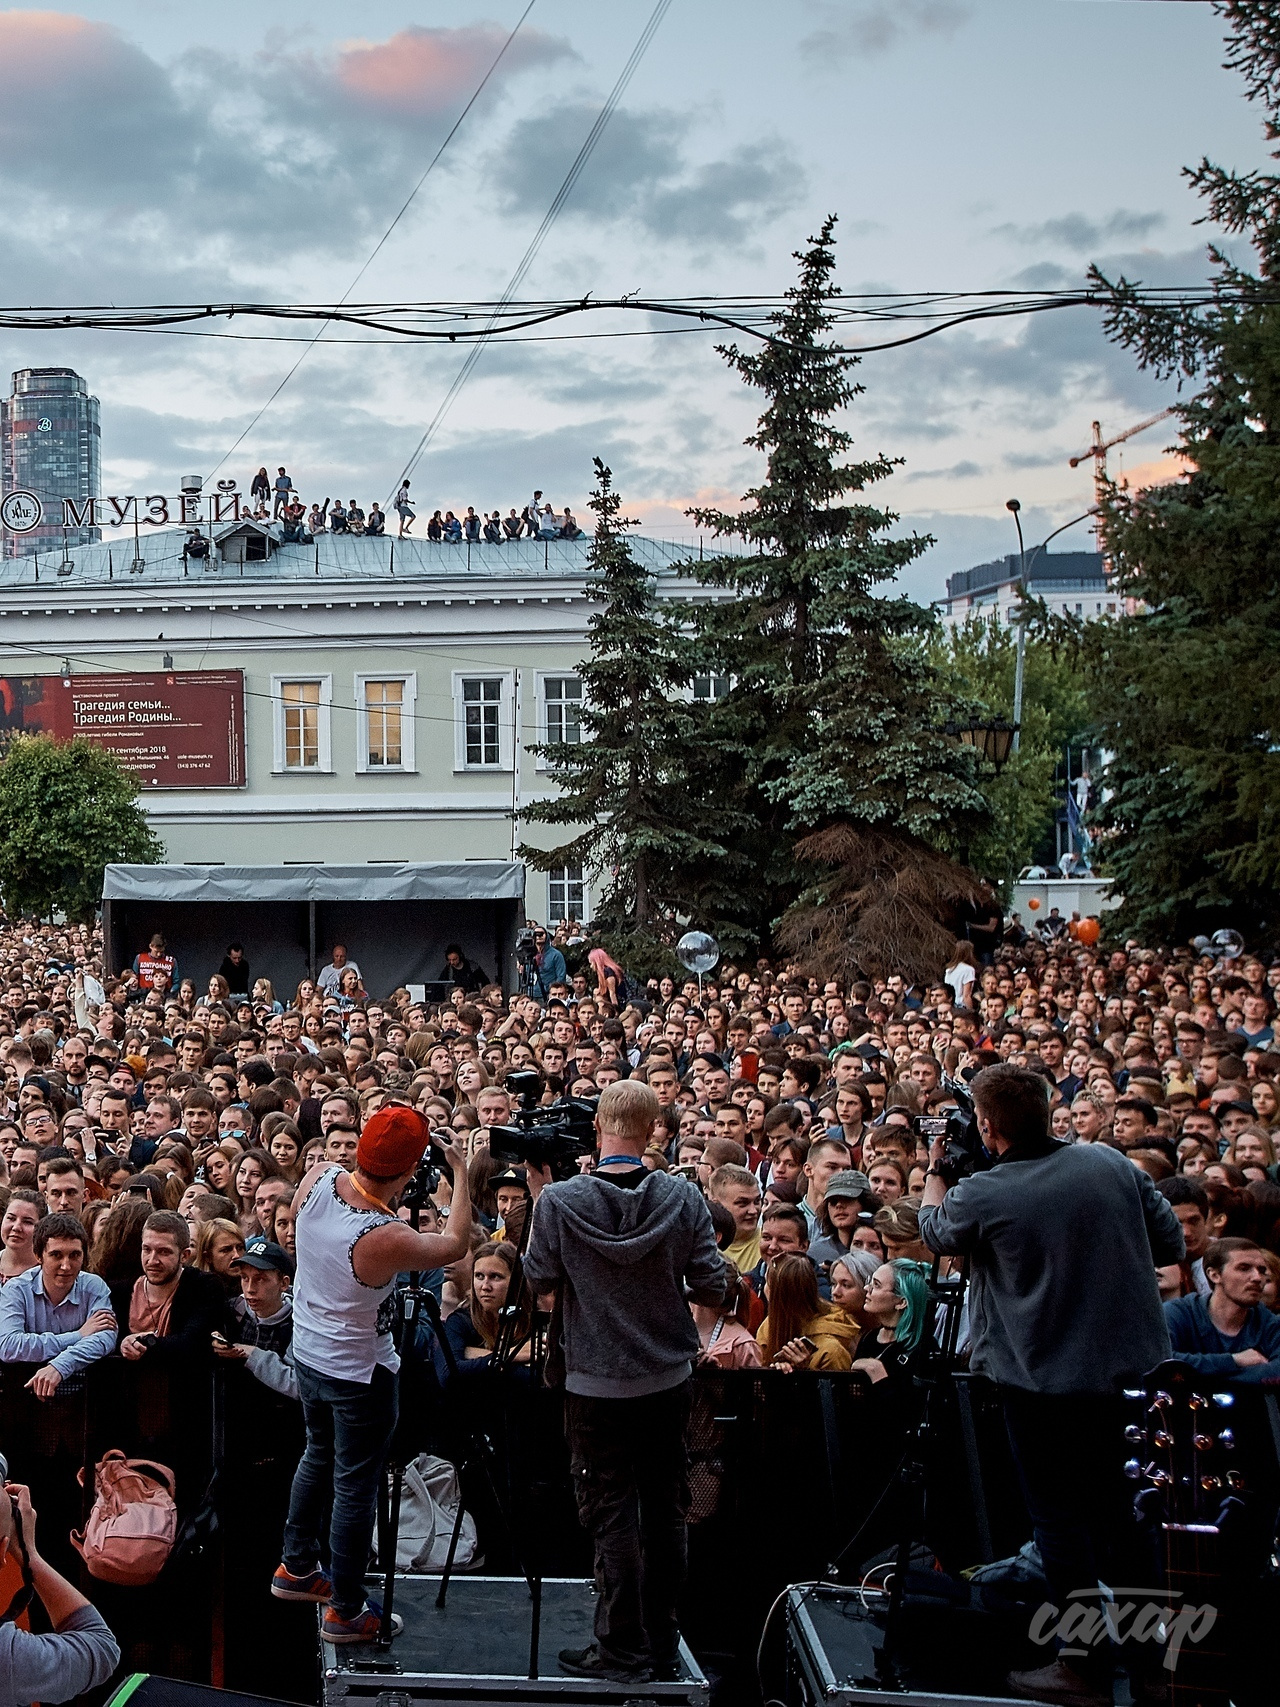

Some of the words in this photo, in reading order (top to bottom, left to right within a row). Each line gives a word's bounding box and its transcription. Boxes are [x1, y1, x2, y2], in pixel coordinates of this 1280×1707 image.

[63, 479, 243, 528] МУЗЕЙ
[73, 700, 125, 712] Трагедия
[127, 700, 171, 710] семьи...
[73, 712, 125, 726] Трагедия
[128, 711, 182, 723] Родины...
[116, 746, 148, 754] сентября
